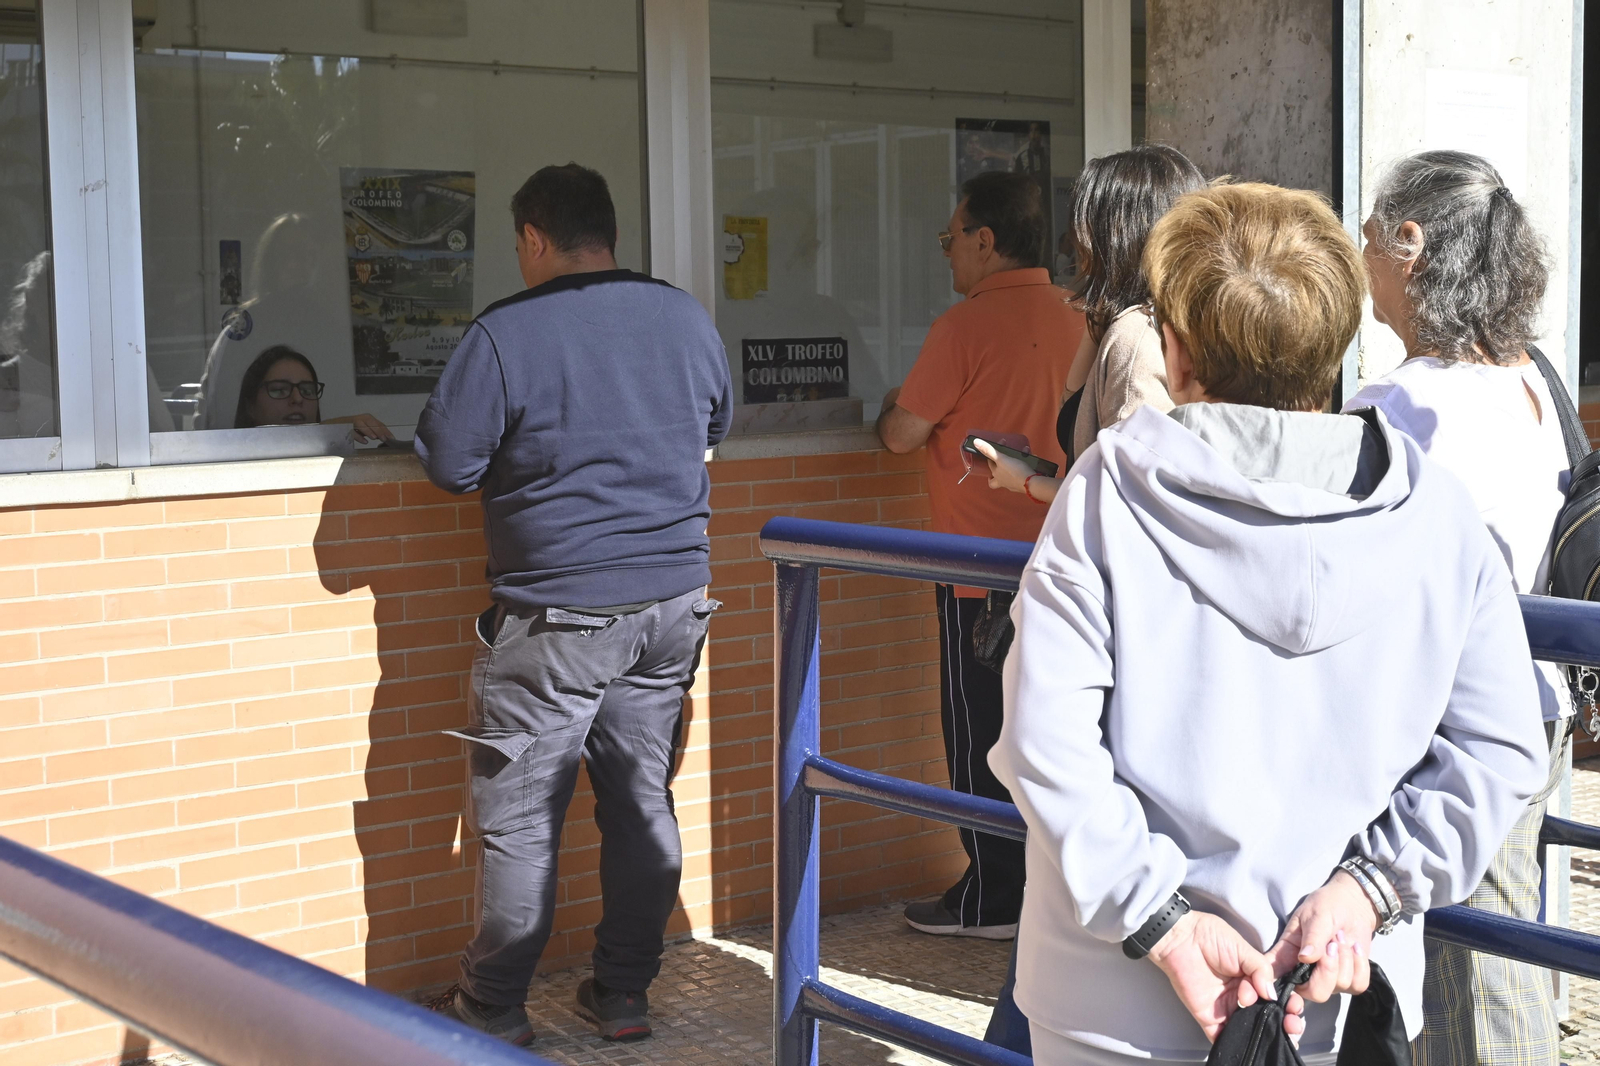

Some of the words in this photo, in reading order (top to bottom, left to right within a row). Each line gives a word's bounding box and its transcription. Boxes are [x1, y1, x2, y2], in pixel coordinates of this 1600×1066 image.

[351, 190, 402, 199] TROFEO
[351, 199, 403, 208] COLOMBINO
[747, 345, 776, 361] XLV
[785, 343, 844, 360] TROFEO
[748, 365, 844, 386] COLOMBINO
